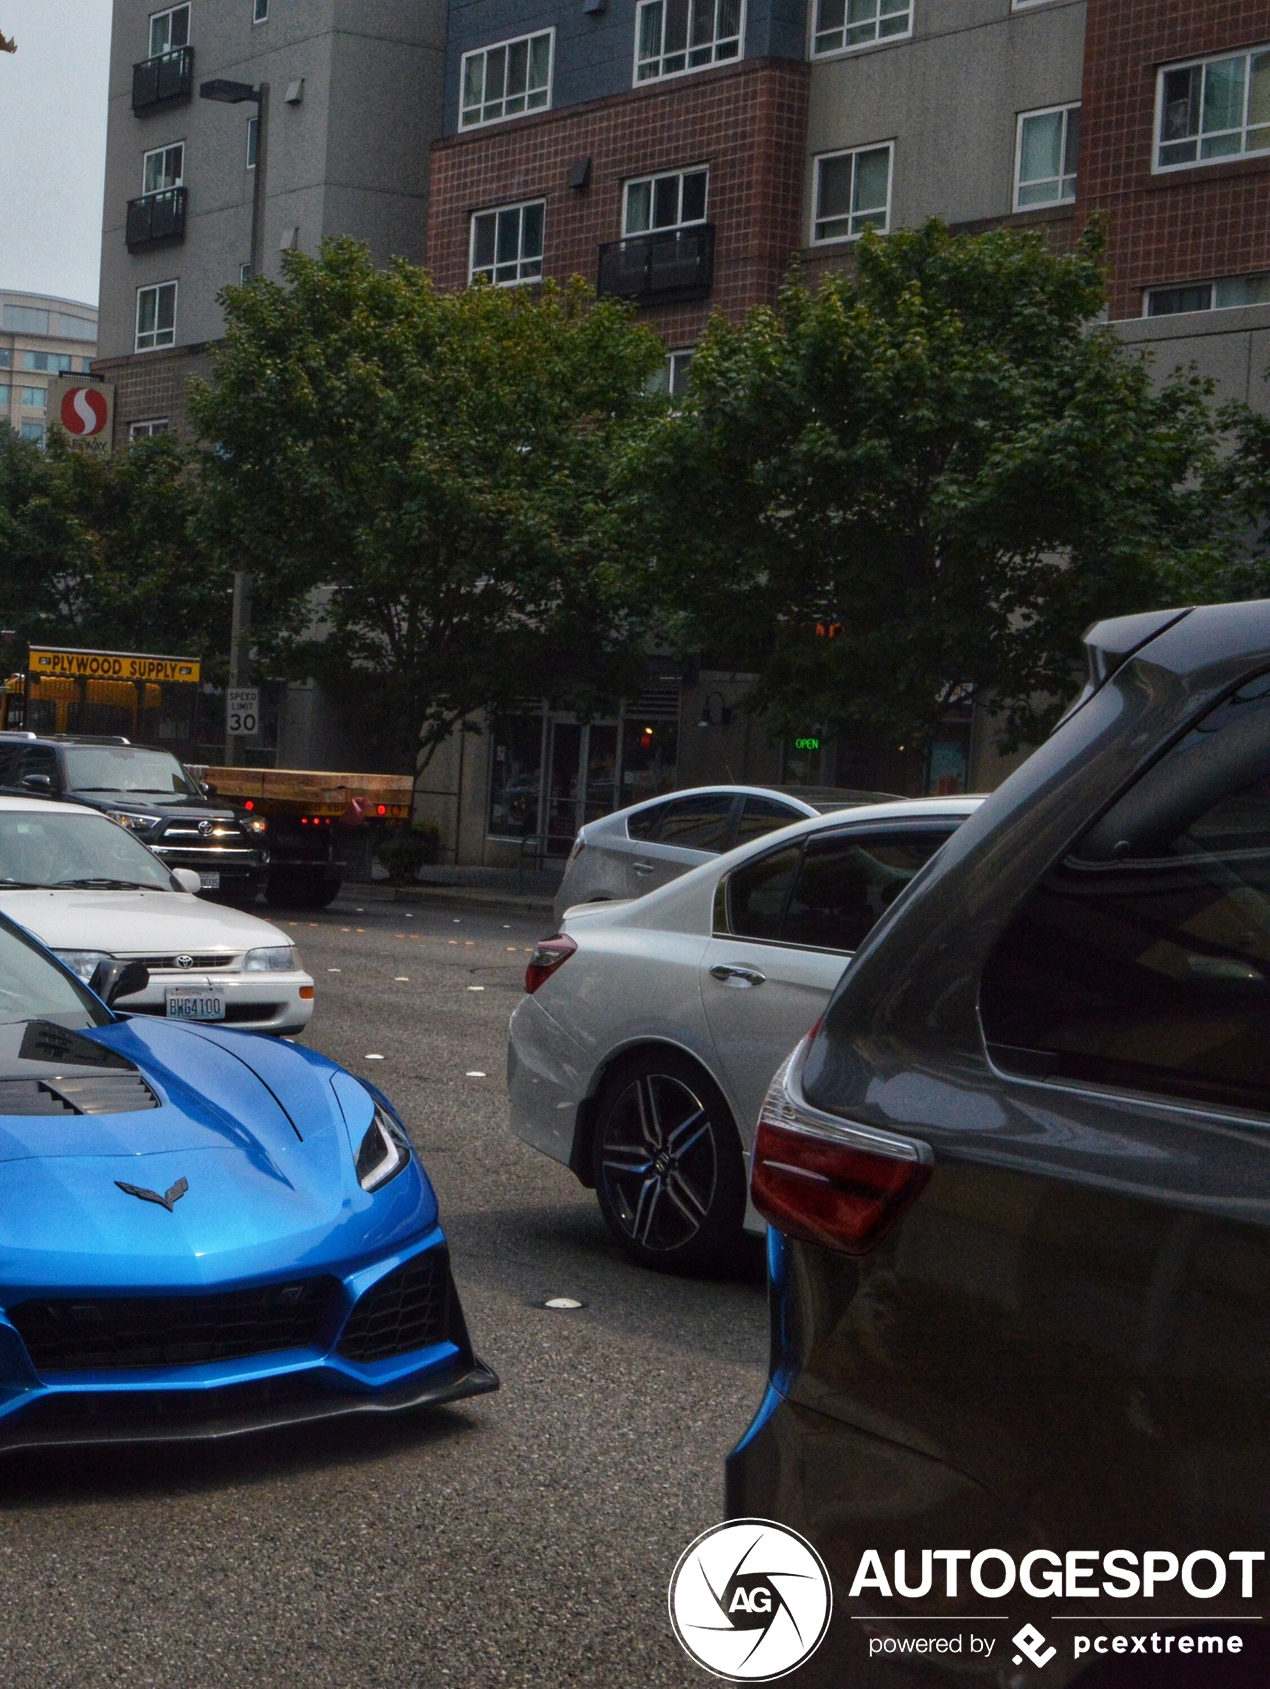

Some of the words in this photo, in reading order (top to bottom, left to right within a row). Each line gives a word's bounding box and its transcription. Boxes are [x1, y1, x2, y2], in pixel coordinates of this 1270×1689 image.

[52, 655, 122, 675] PLYWOOD
[129, 660, 178, 678] SUPPLY
[229, 692, 257, 700] SPEED
[231, 702, 253, 710] LIMIT
[230, 713, 256, 731] 30
[795, 738, 819, 750] OPEN
[169, 998, 221, 1015] BWG4100
